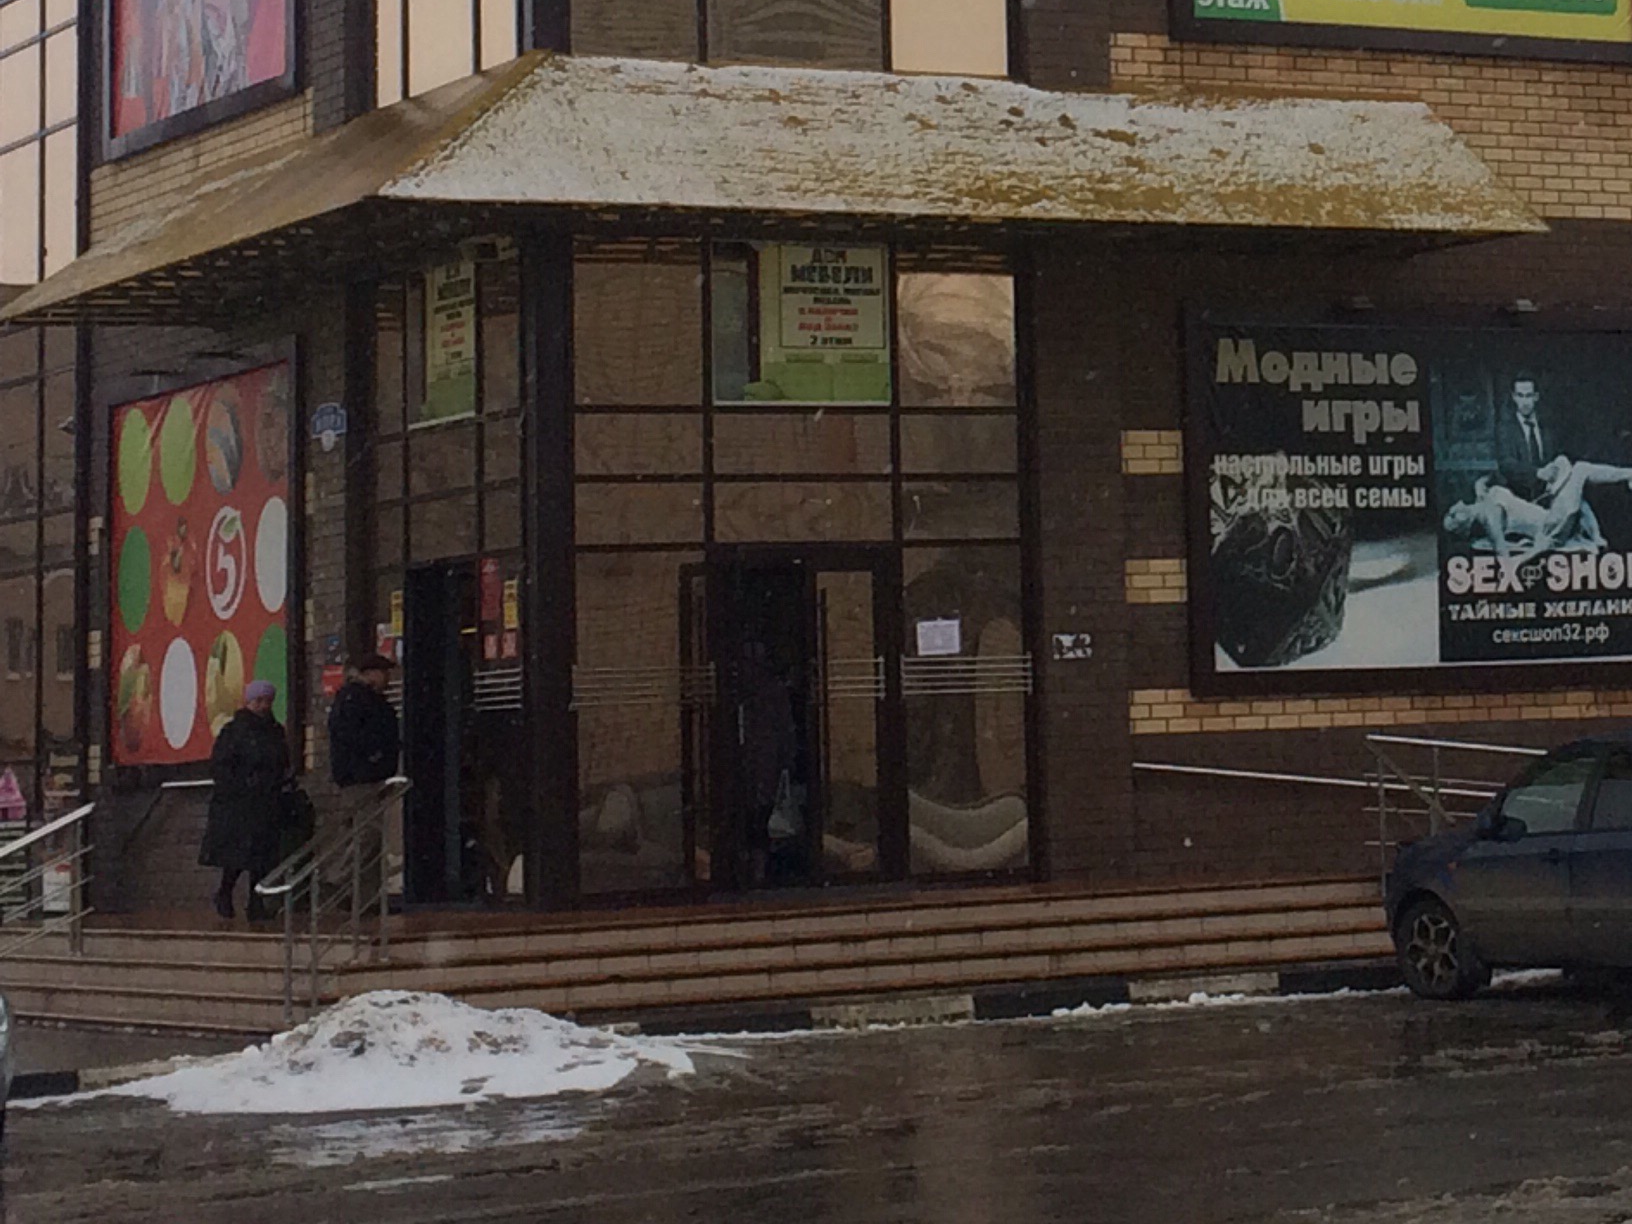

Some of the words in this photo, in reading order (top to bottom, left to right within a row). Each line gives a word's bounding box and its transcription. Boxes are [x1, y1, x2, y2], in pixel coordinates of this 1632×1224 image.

[790, 263, 873, 284] МЕБЕЛИ
[1216, 338, 1418, 392] Модные
[1302, 398, 1420, 444] игры
[1213, 453, 1362, 478] настольные
[1369, 454, 1425, 480] игры
[1295, 482, 1349, 509] всей
[1355, 487, 1426, 508] семьи
[1447, 554, 1524, 595] SEX
[1448, 599, 1536, 622] ТАЙНЫЕ
[1492, 623, 1610, 645] сексшоп32.рф
